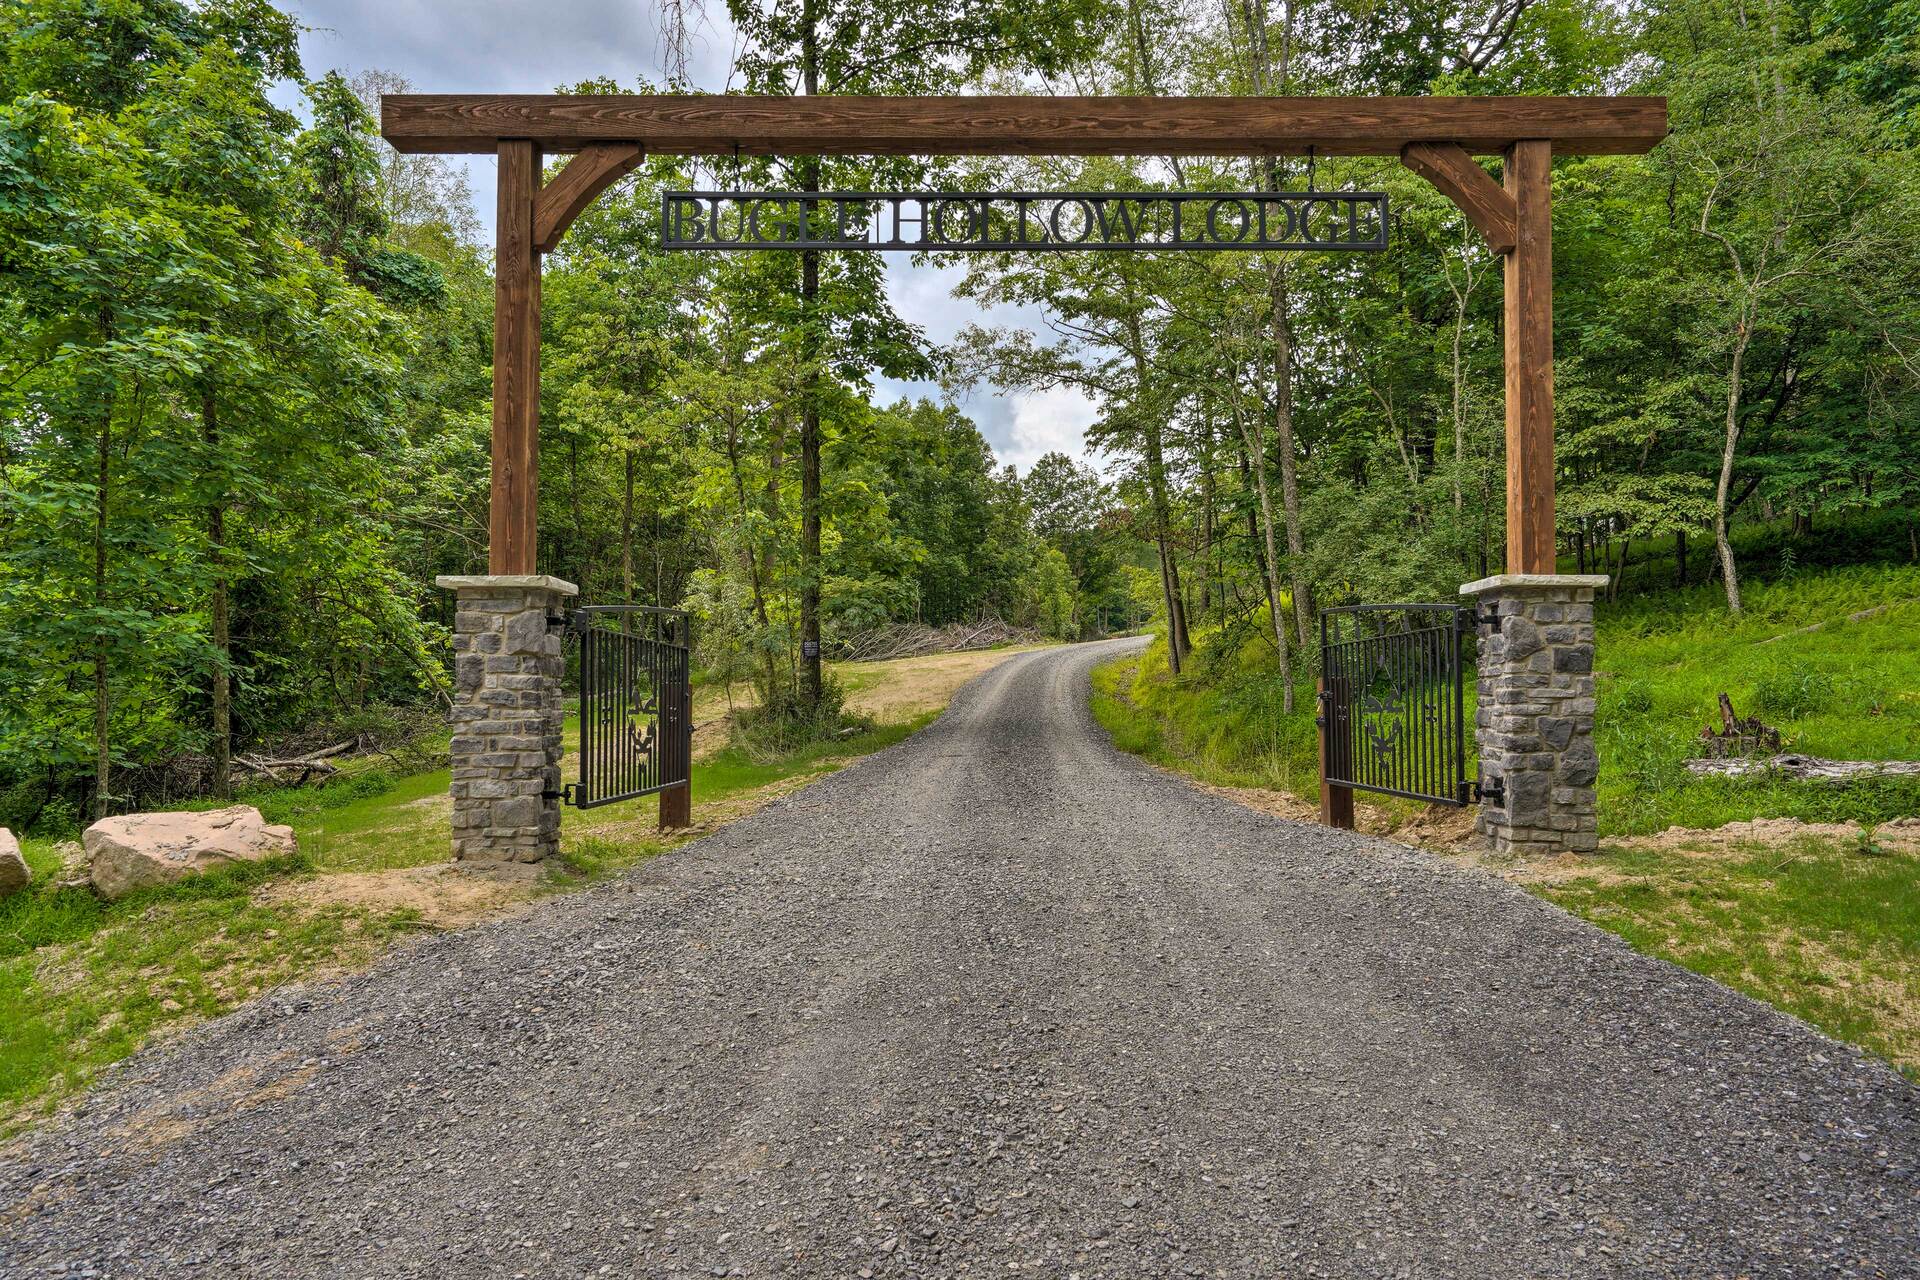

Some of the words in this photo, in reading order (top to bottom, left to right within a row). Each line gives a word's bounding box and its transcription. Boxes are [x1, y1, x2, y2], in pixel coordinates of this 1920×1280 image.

[672, 199, 870, 243] BUGLE
[888, 199, 1149, 243] HOLLOW
[1167, 199, 1382, 243] LODGE
